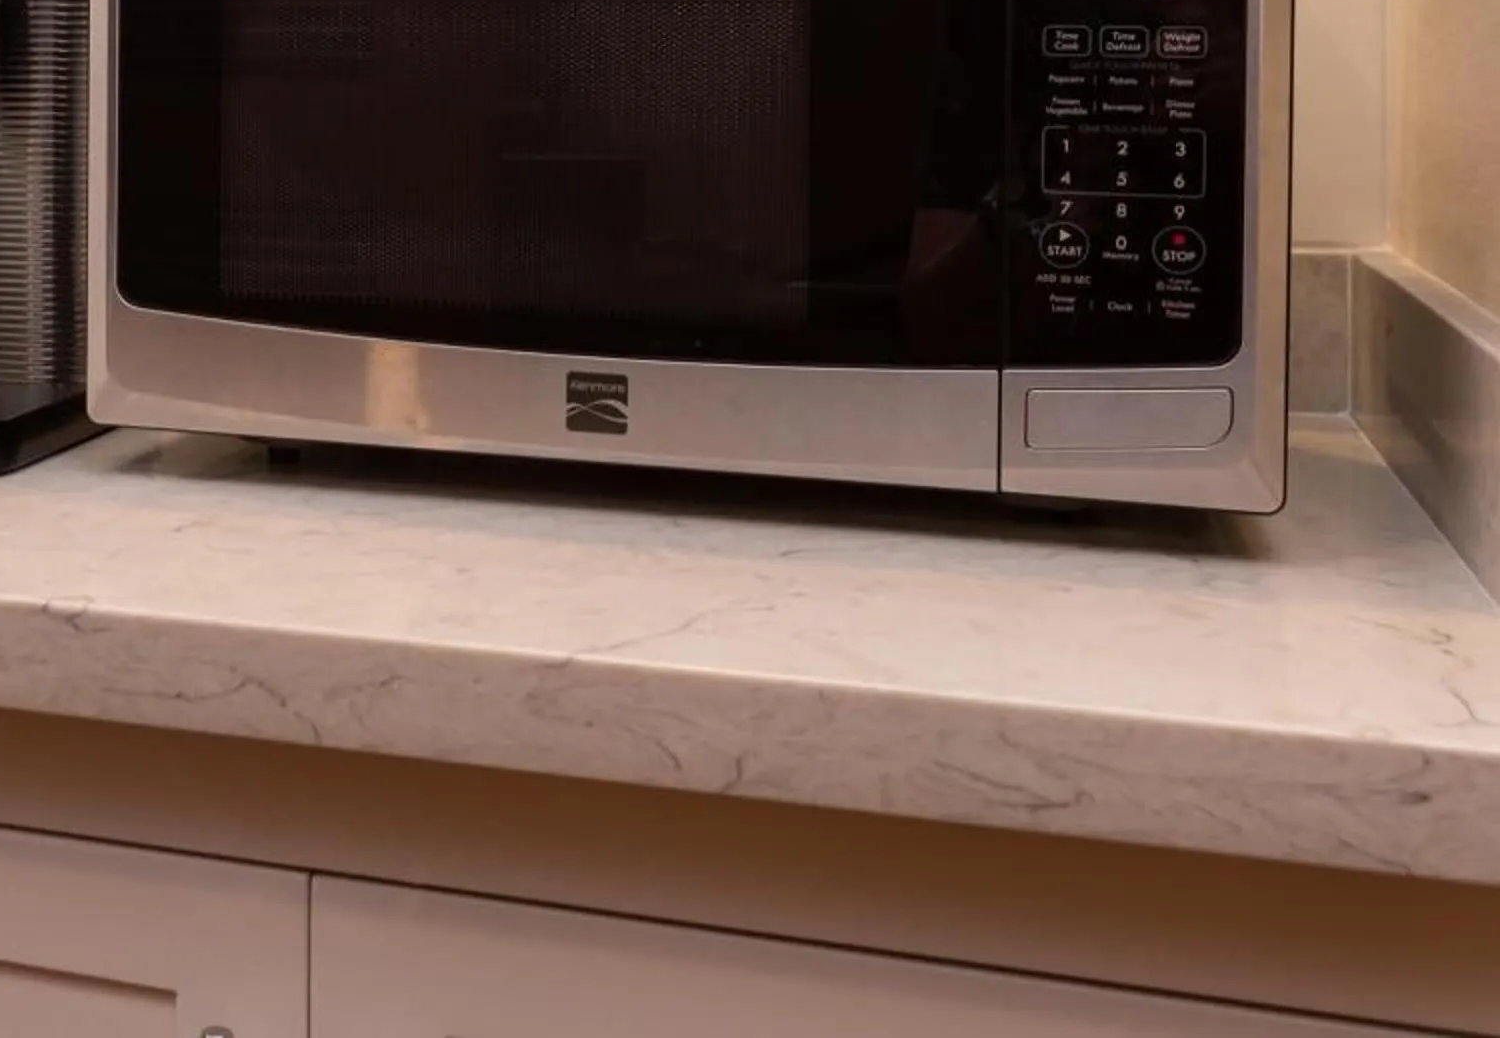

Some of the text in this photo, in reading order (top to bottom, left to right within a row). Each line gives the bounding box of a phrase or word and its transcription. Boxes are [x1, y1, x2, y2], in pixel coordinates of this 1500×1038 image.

[1111, 31, 1136, 42] Time
[1163, 32, 1201, 43] Weight
[1105, 41, 1141, 51] Defrost
[1061, 138, 1070, 154] 1
[1117, 140, 1129, 156] 2
[1175, 141, 1187, 158] 3
[1060, 171, 1071, 185] 4
[1115, 171, 1128, 187] 5
[1173, 173, 1186, 190] 6
[1060, 200, 1074, 216] 7
[1115, 202, 1128, 218] 8
[1173, 204, 1186, 220] 9
[1047, 244, 1083, 257] START
[1115, 235, 1128, 251] 0
[1162, 249, 1196, 263] STOP
[1107, 300, 1133, 312] Clock
